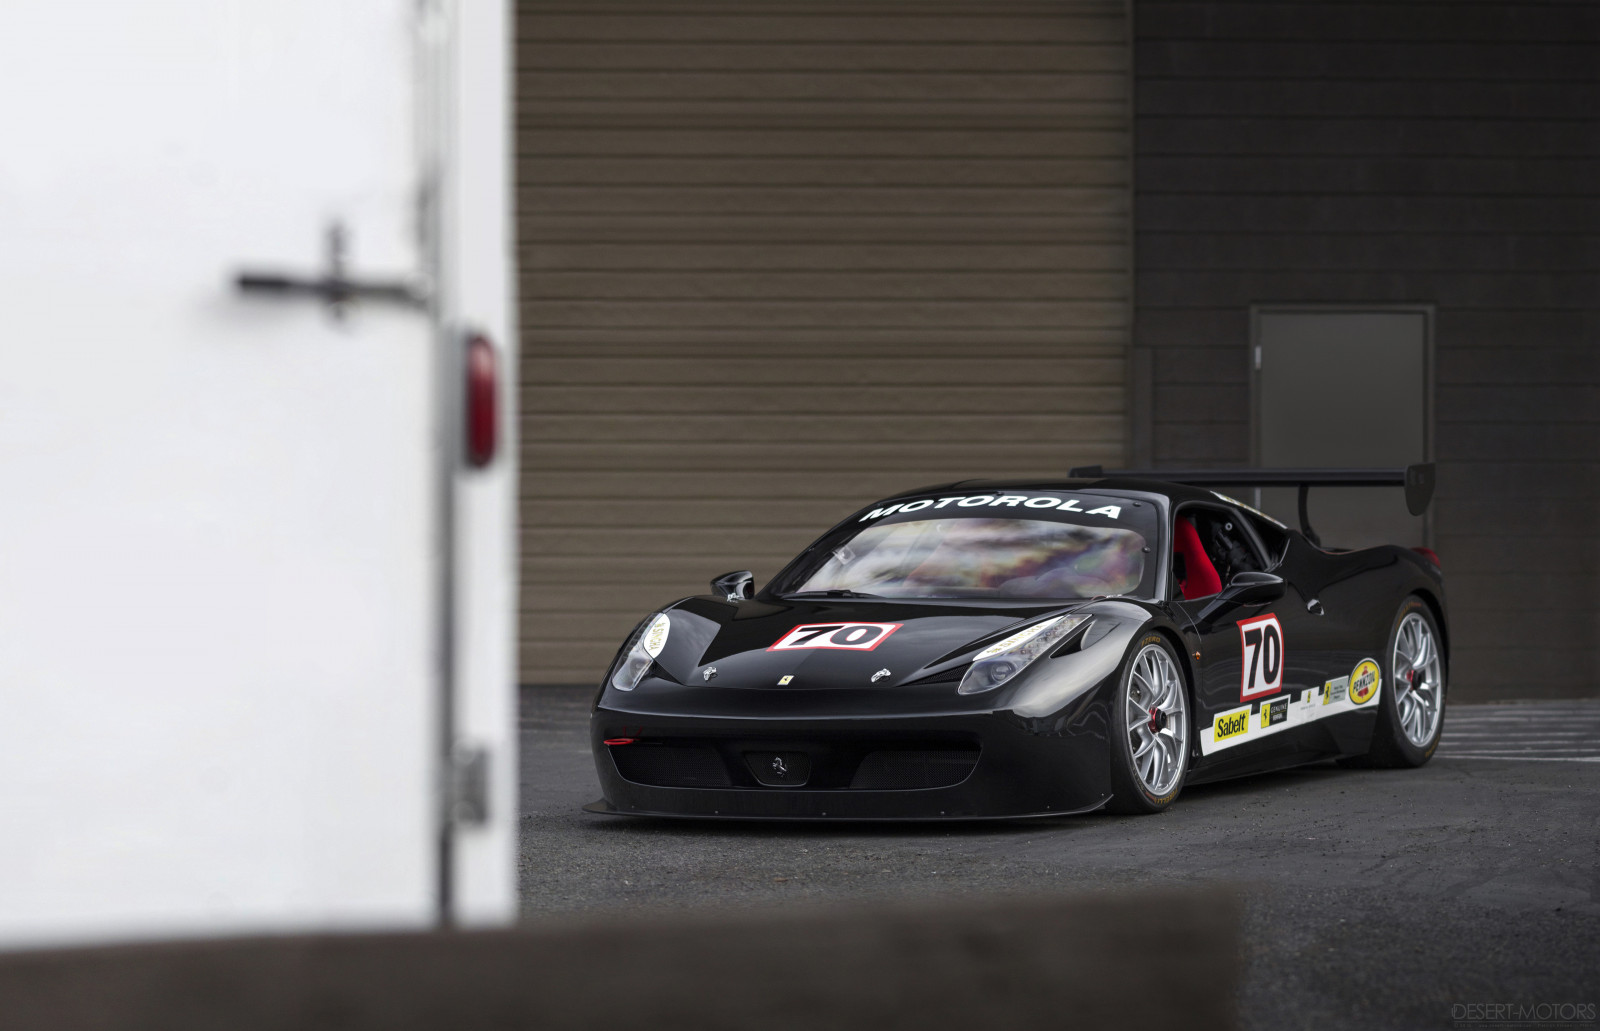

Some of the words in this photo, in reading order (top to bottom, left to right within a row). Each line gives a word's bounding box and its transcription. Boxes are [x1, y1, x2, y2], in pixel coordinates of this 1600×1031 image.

[858, 495, 1122, 522] MOTOROLA
[787, 625, 884, 646] 70
[1243, 623, 1281, 690] 70
[1353, 670, 1376, 694] PENNZOIL
[1217, 712, 1246, 738] Sabelt
